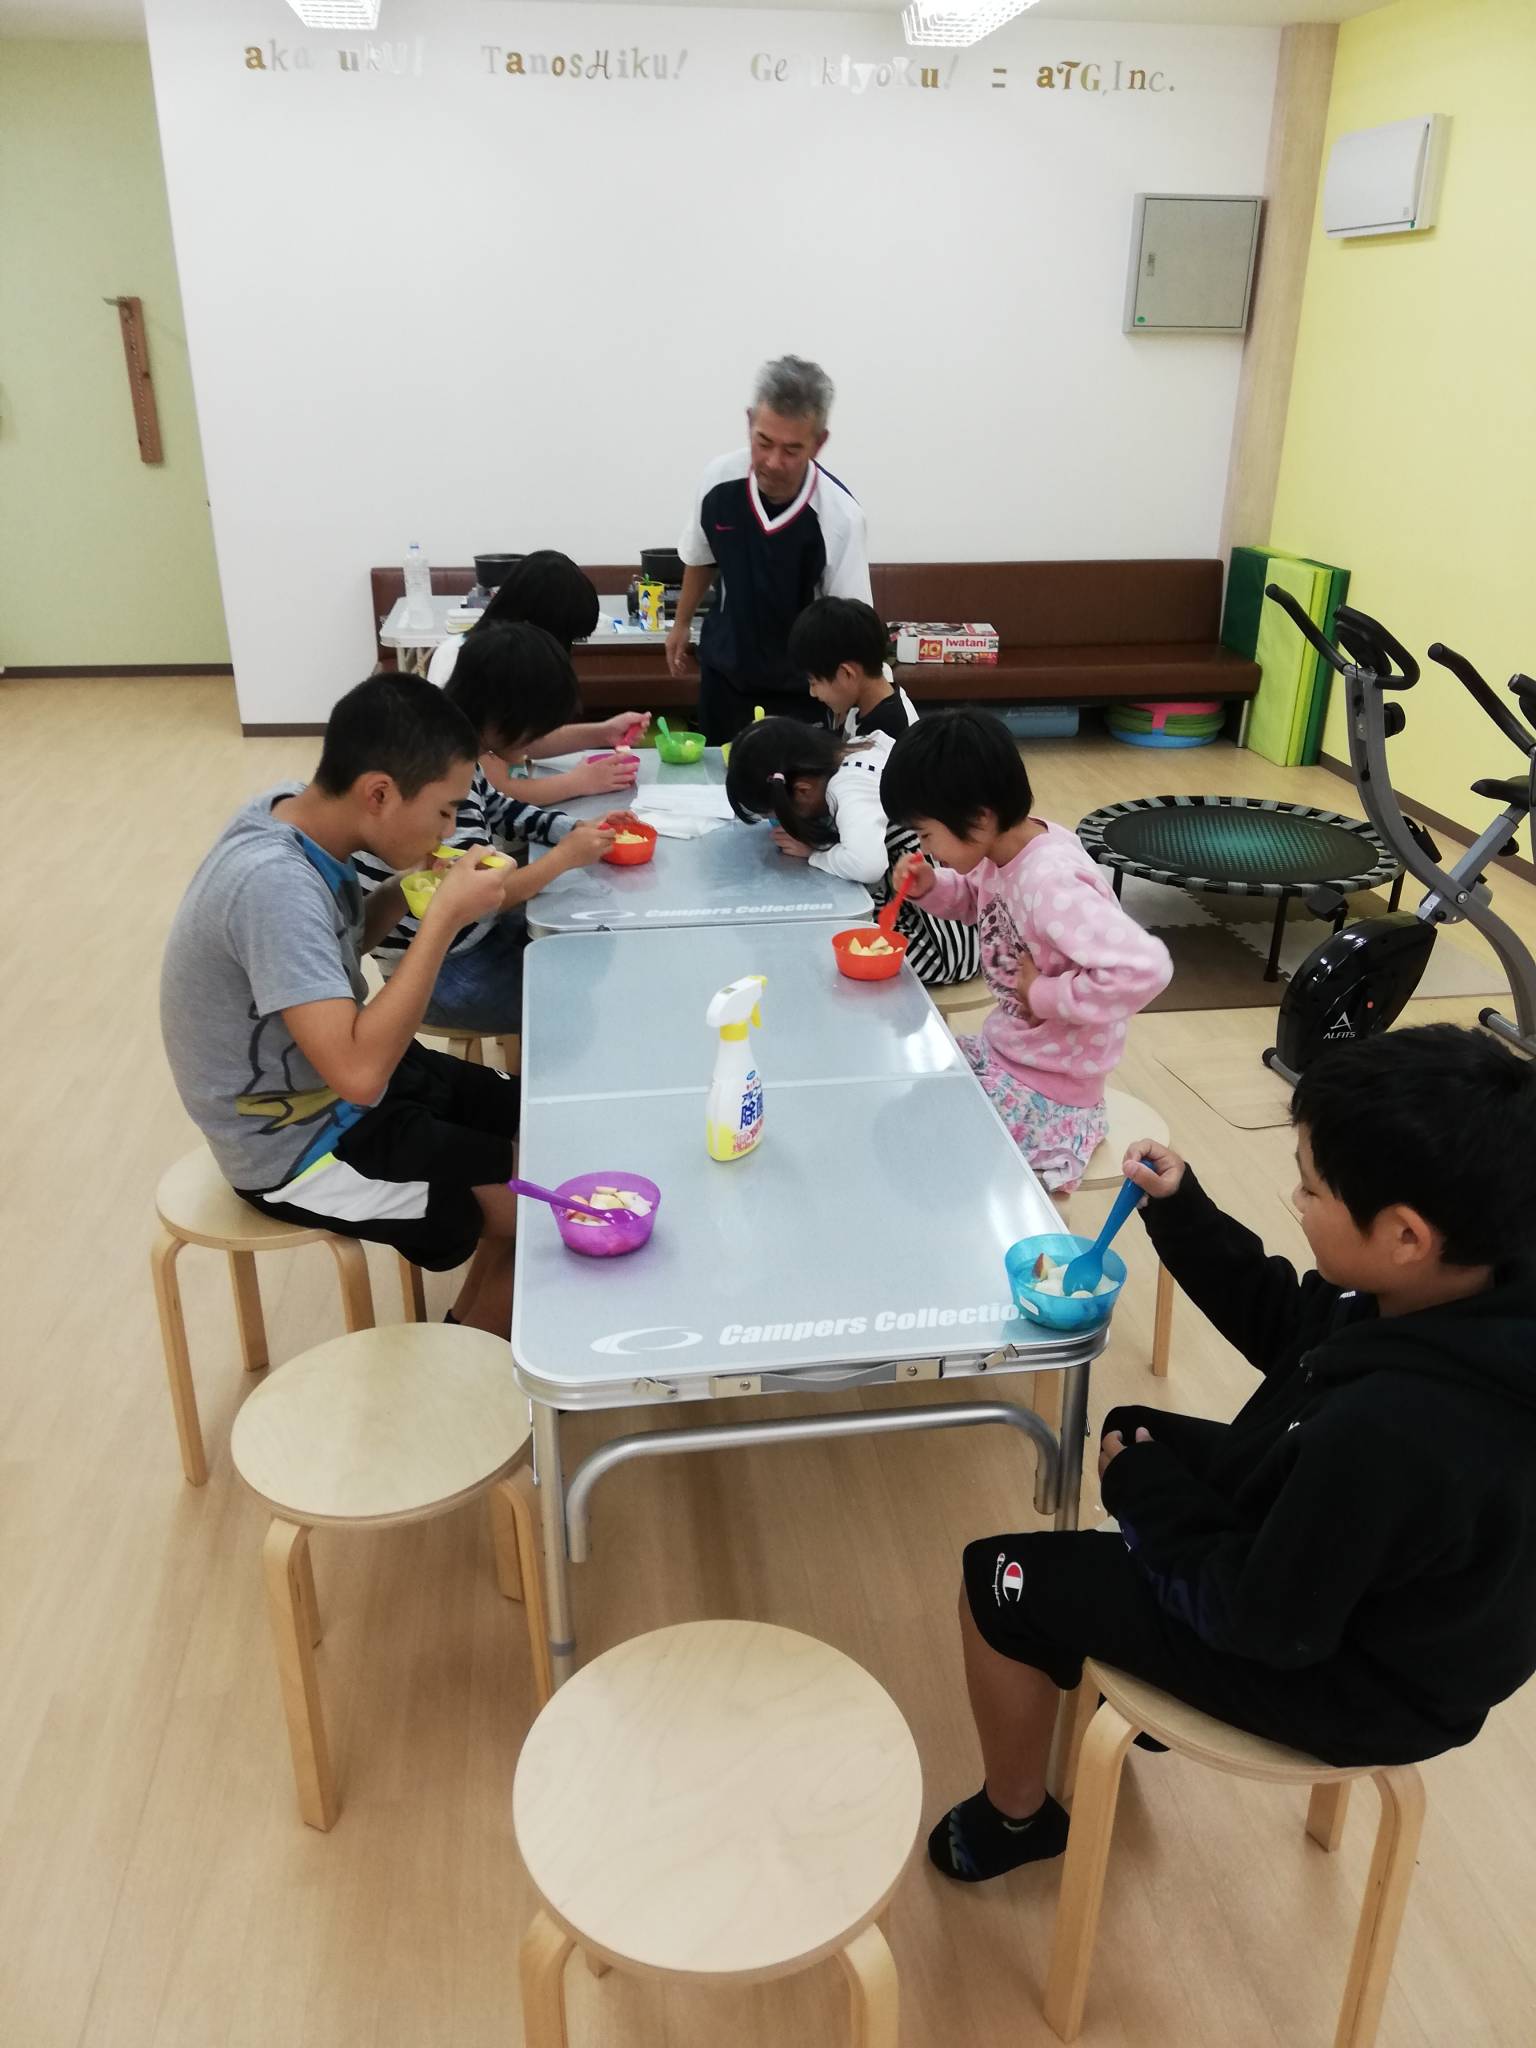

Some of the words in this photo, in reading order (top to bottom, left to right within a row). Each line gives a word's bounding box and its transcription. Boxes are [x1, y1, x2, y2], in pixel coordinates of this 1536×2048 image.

[645, 907, 732, 918] Campers
[735, 902, 833, 915] Collection
[719, 1315, 867, 1346] Campers
[874, 1302, 1027, 1331] Collectio
